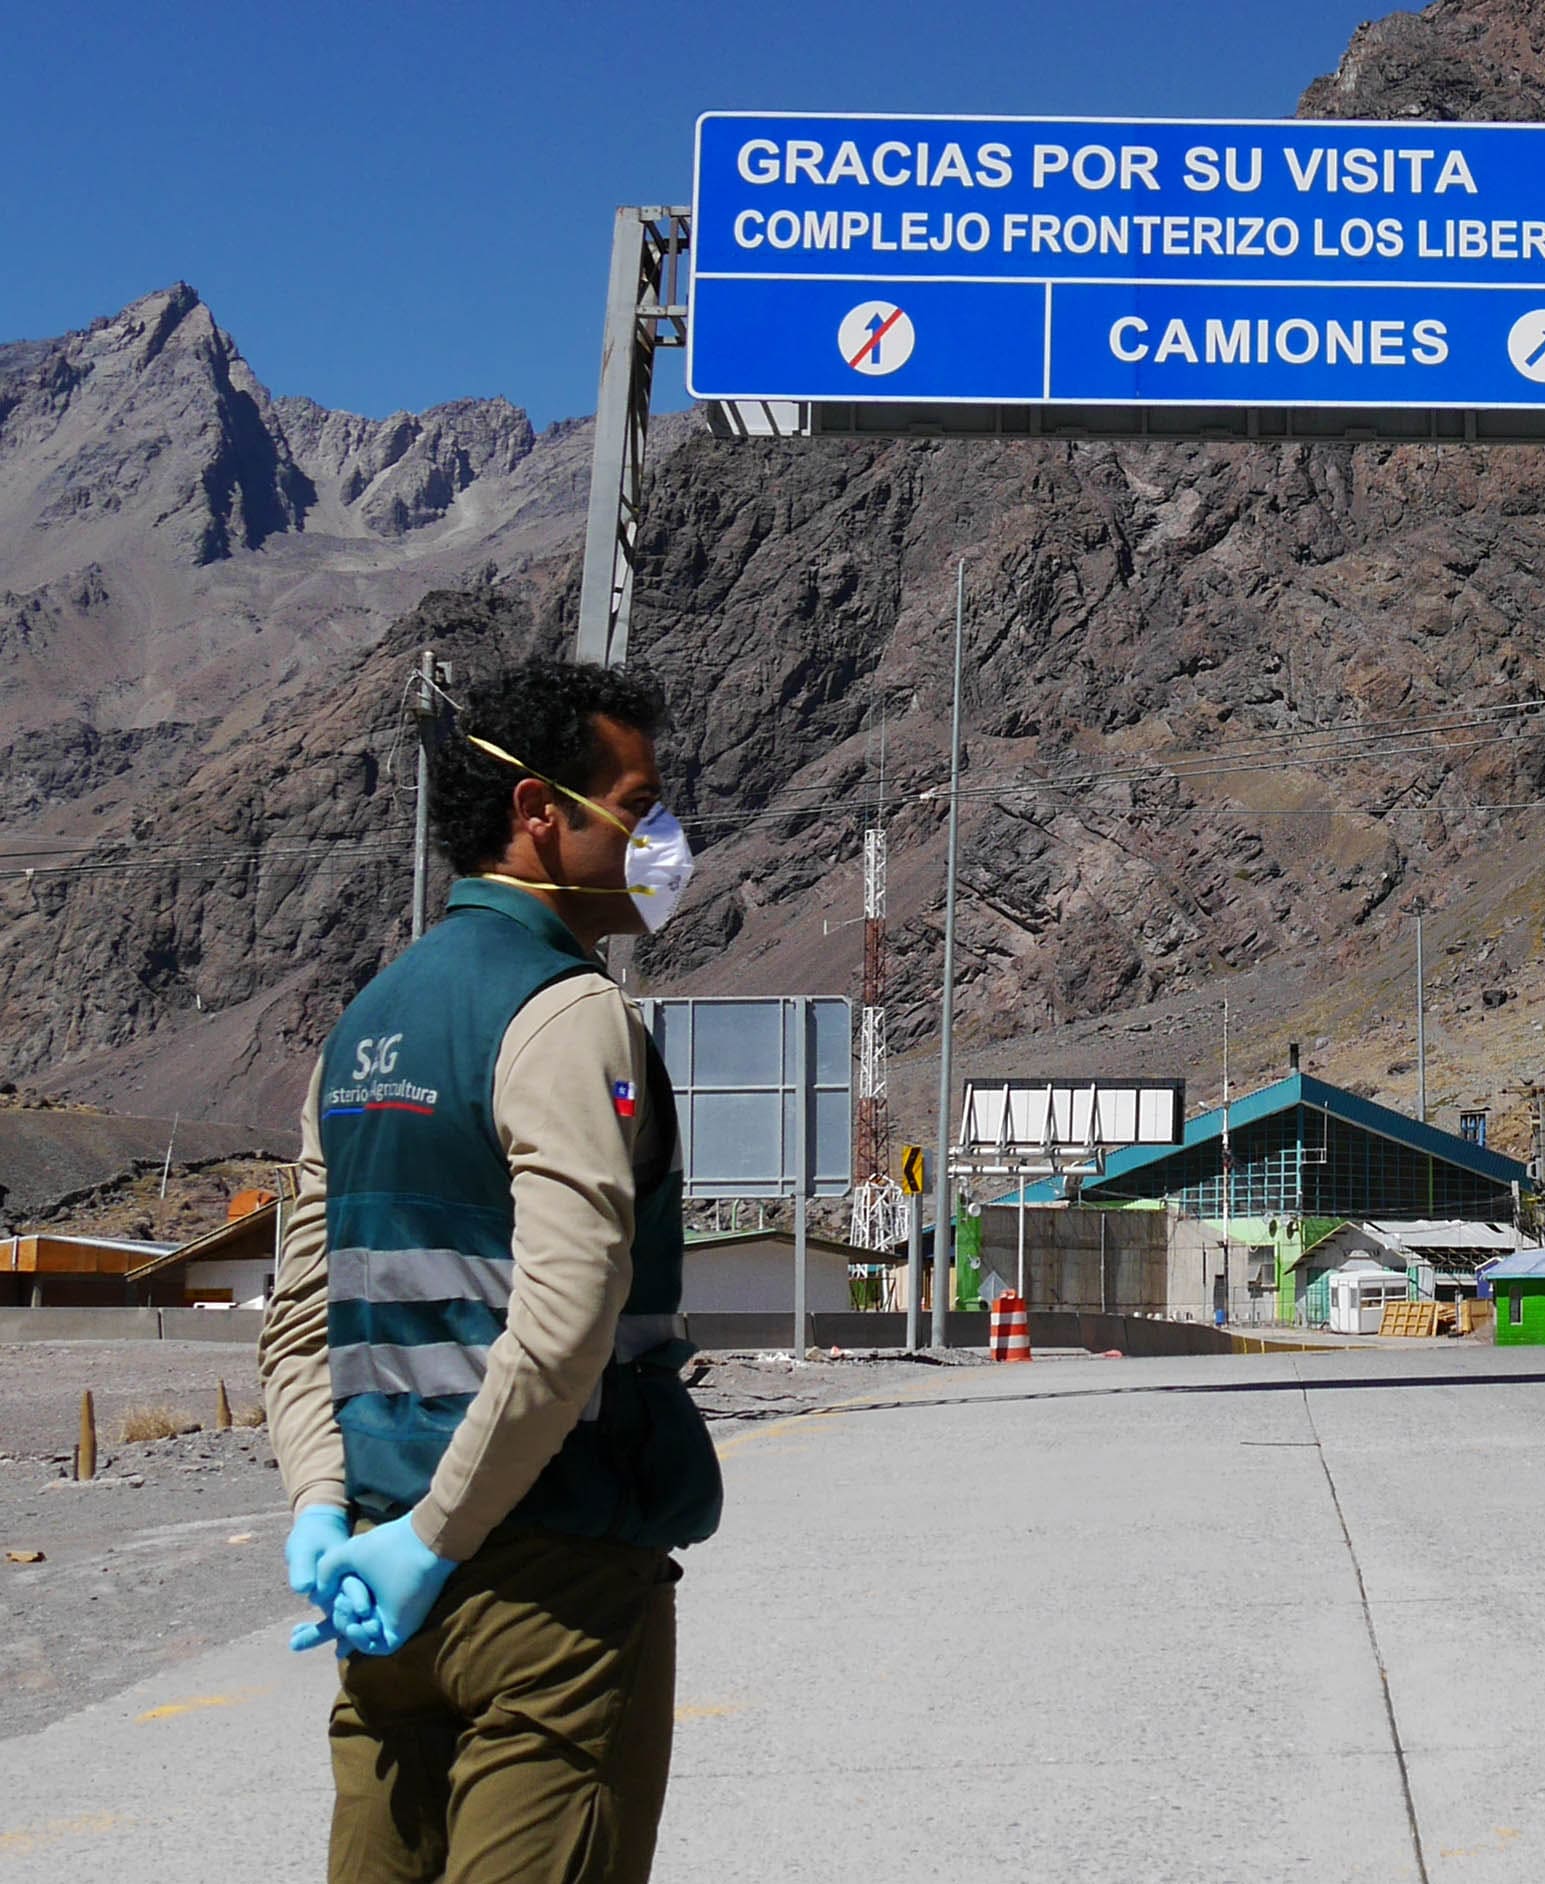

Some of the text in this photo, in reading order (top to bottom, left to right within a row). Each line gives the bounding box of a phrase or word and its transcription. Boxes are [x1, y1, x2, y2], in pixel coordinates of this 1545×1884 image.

[736, 139, 1479, 194] GRACIAS POR SU VISITA
[733, 209, 991, 252] COMPLEJO
[1003, 214, 1301, 257] FRONTERIZO
[1314, 218, 1405, 258] LOS
[1108, 316, 1450, 366] CAMIONES
